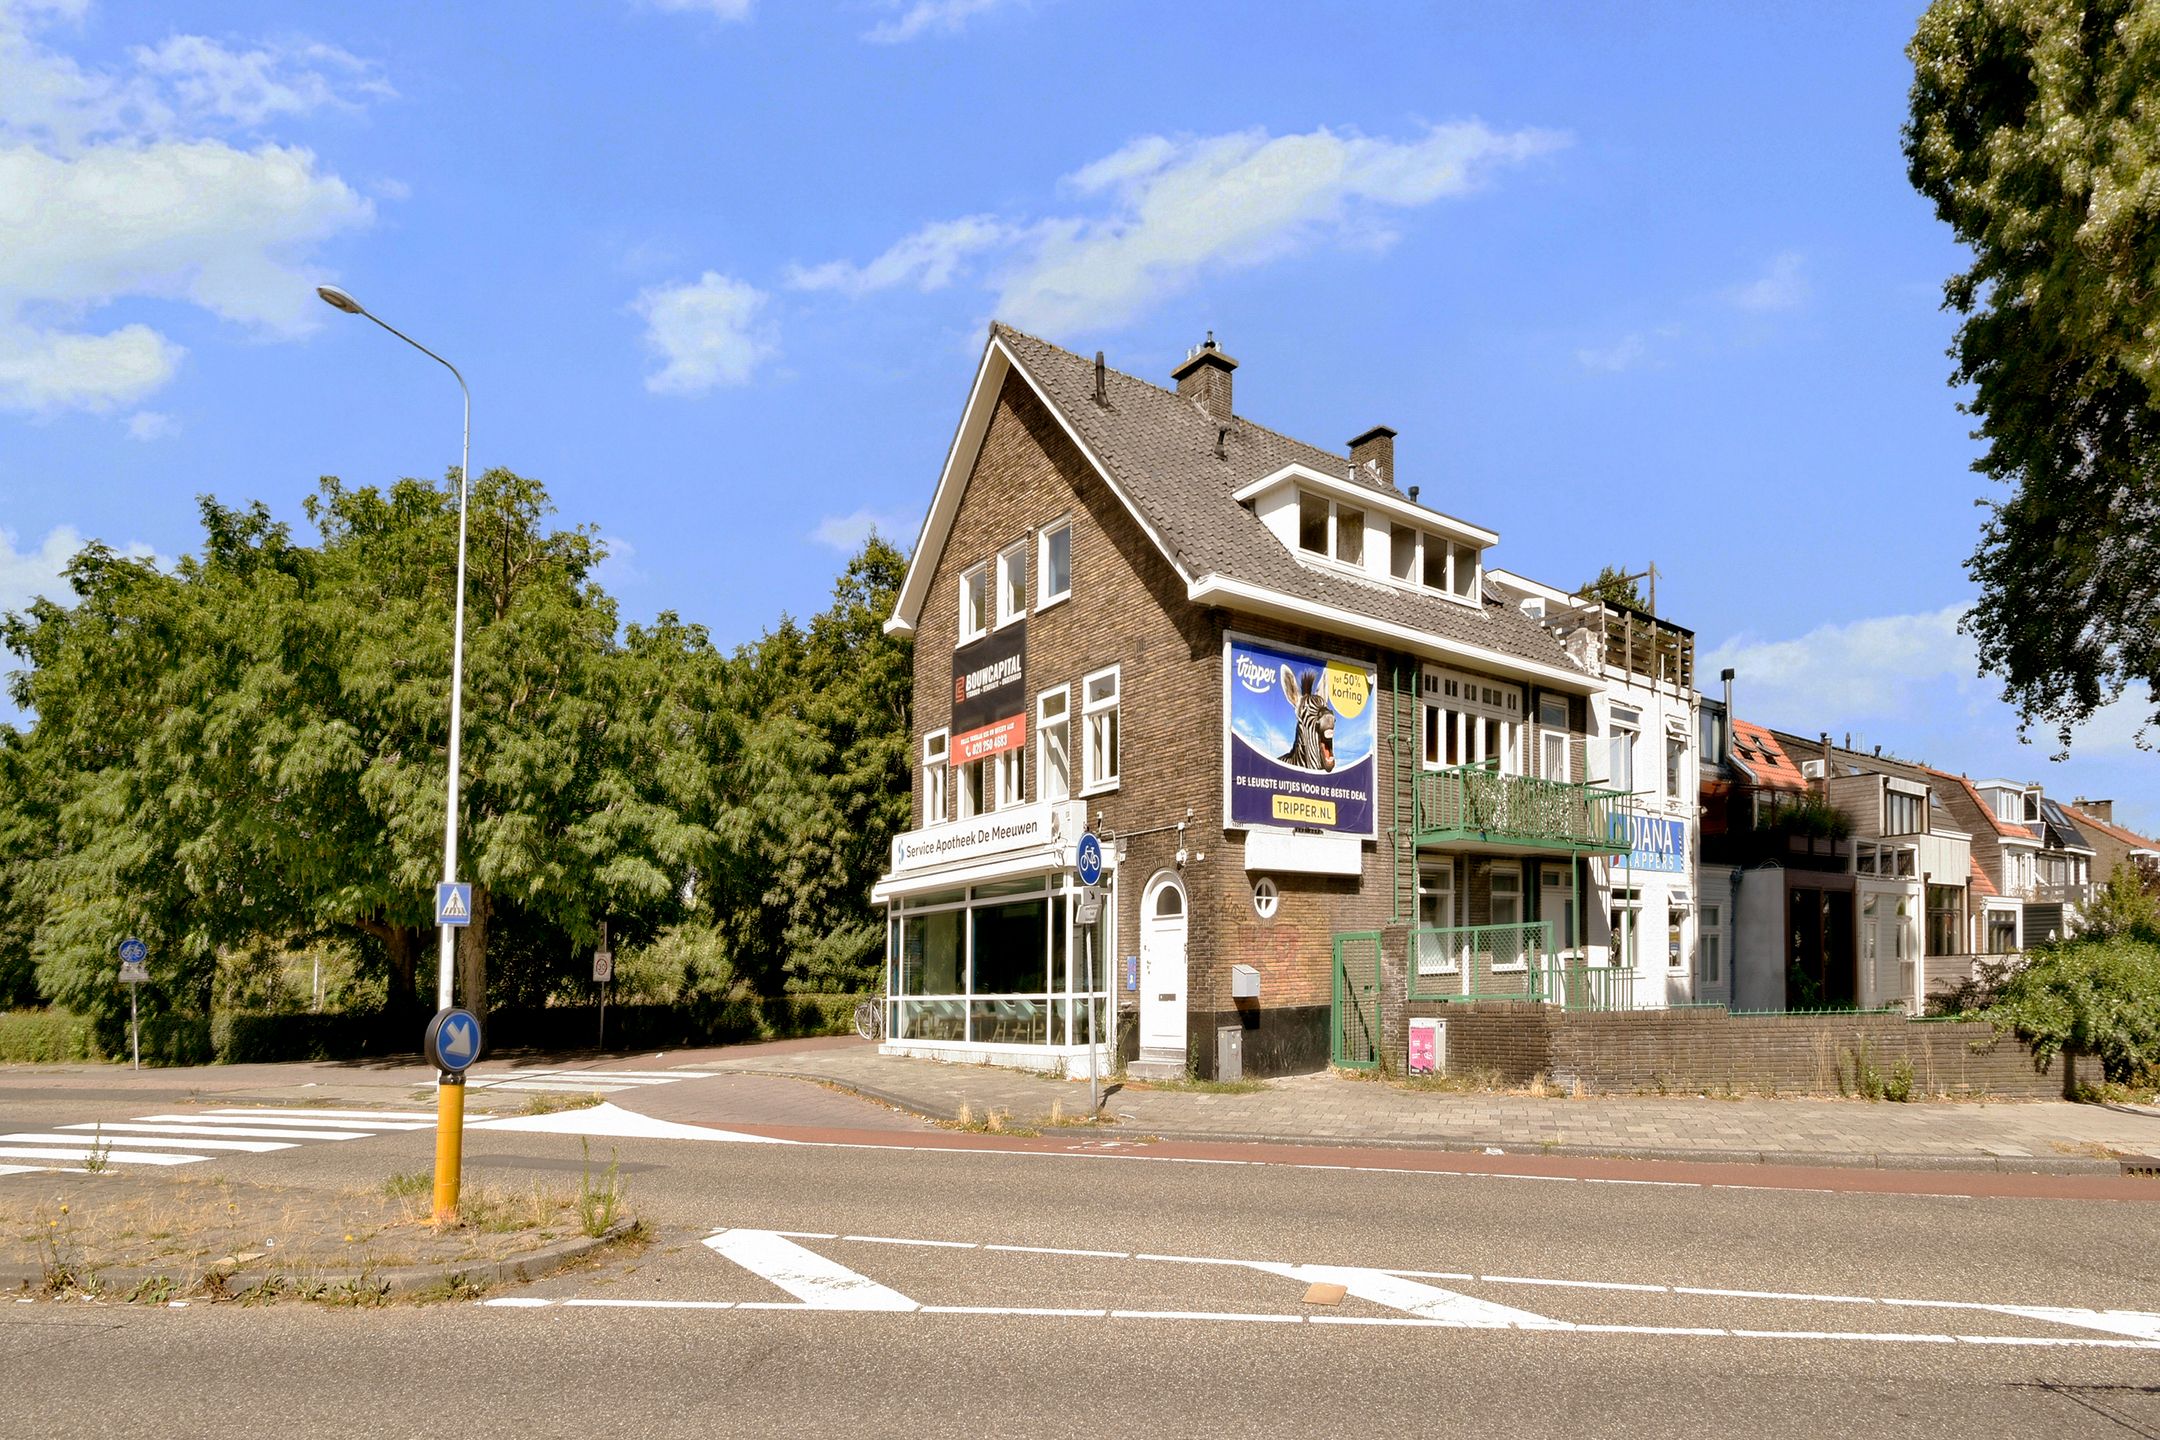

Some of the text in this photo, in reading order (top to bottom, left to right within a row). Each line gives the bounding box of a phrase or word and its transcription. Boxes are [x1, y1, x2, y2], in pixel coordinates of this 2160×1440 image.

[966, 654, 1022, 692] BOUWCAPITAL
[1236, 654, 1276, 687] tripper
[1333, 673, 1361, 688] tot 50%
[1332, 684, 1362, 705] korting
[1236, 776, 1368, 801] DE LEUKSTE UITJES VOOR DE BESTE DEAL
[1277, 801, 1332, 820] TRIPPER.NL
[906, 821, 1038, 858] Service Apotheek De Meeuwen
